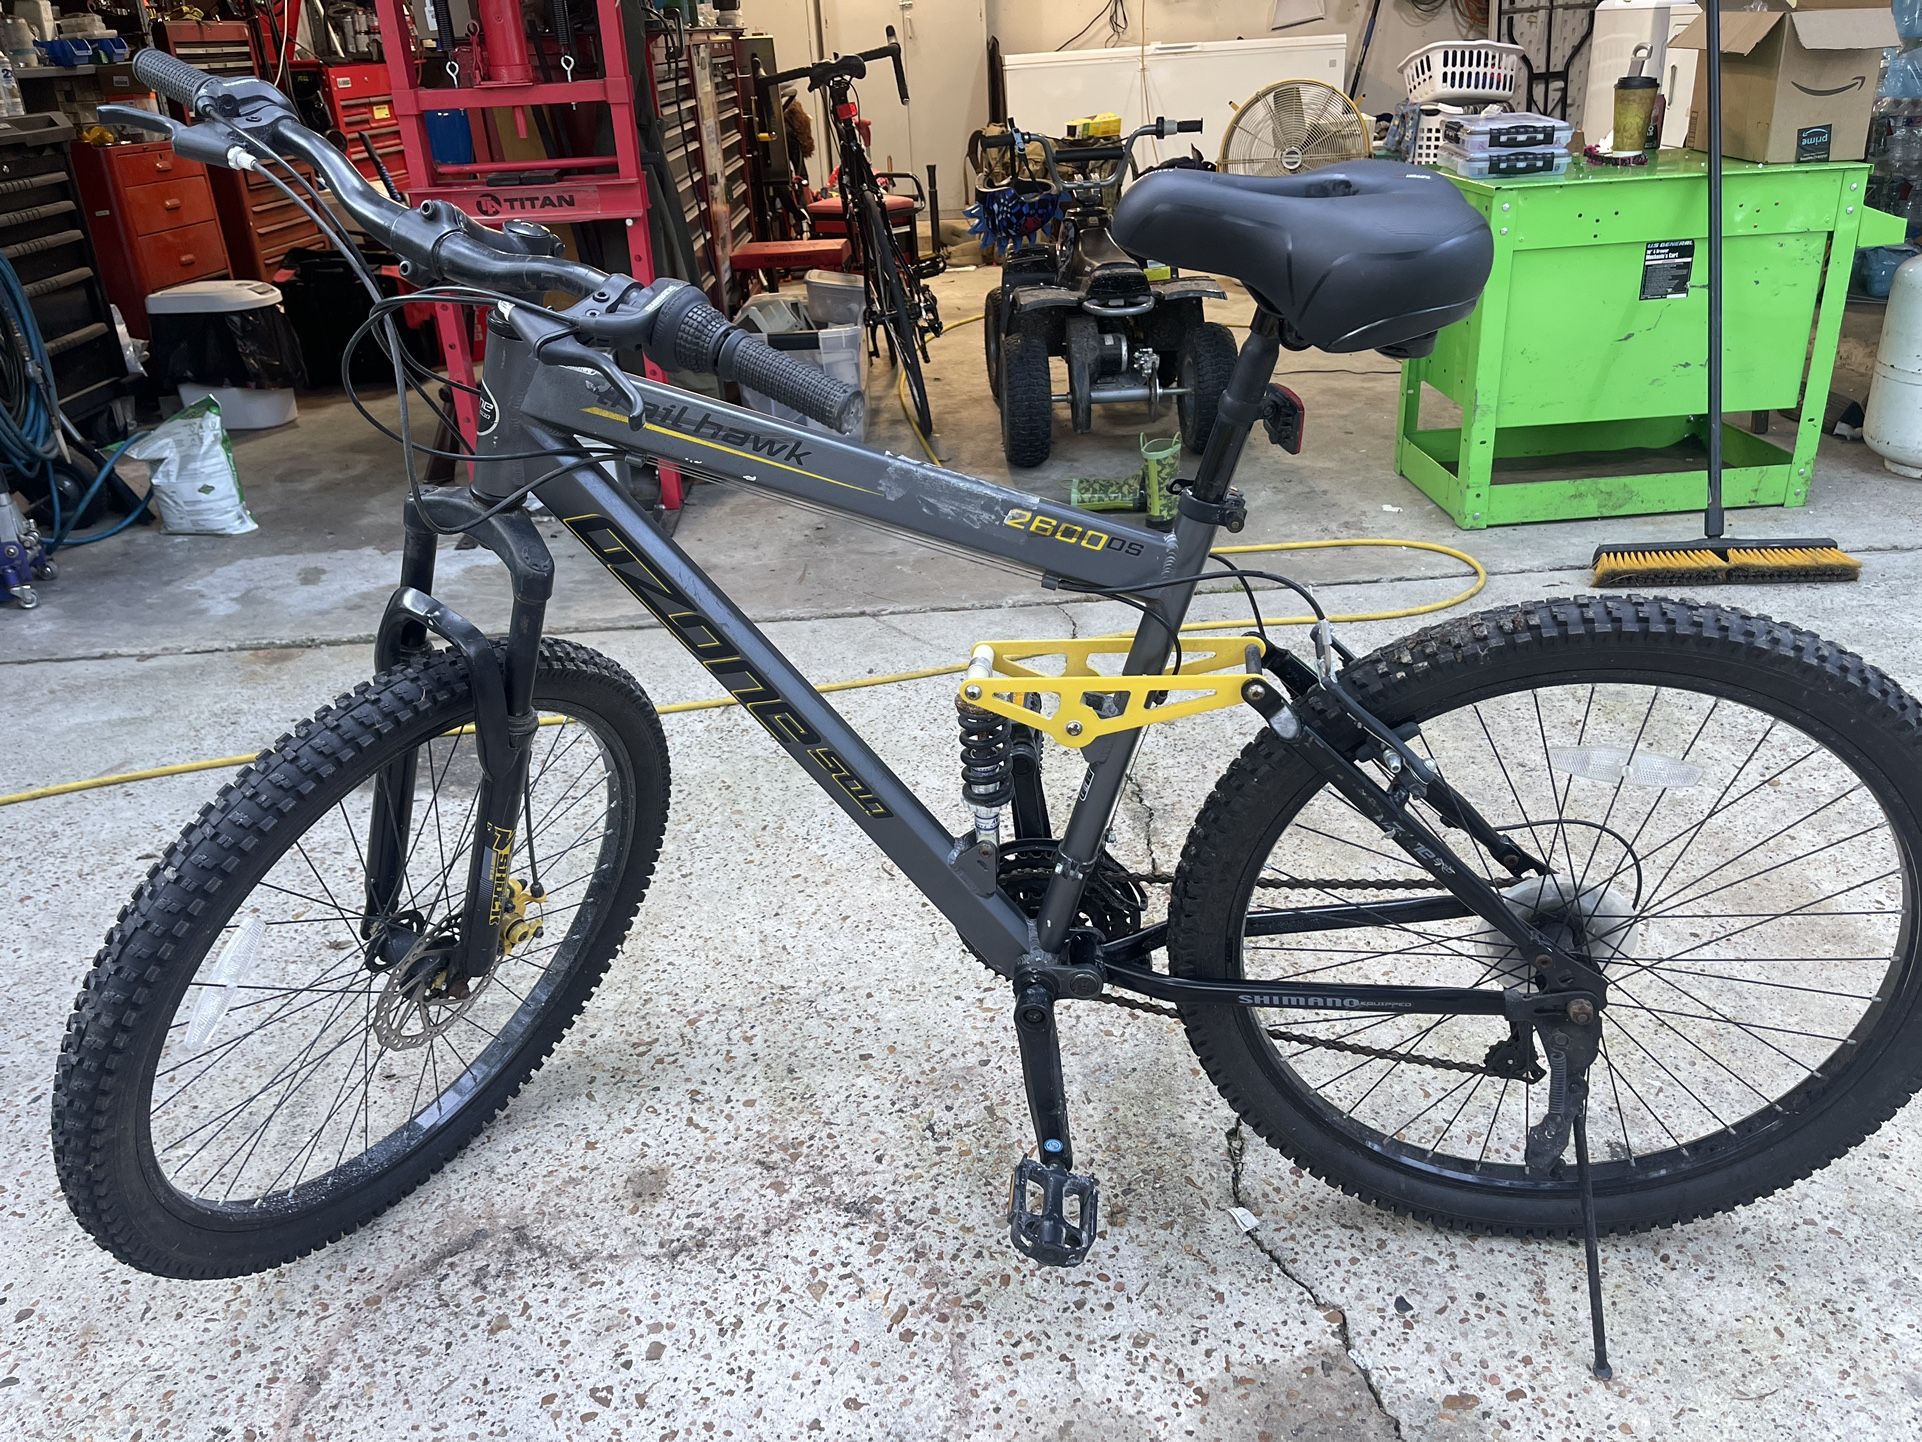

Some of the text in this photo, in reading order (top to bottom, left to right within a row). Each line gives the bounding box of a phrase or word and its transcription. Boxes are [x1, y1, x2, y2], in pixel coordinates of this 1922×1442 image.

[1801, 133, 1828, 145] prime
[504, 195, 576, 210] TITAN
[1238, 994, 1360, 1008] SHIMANO
